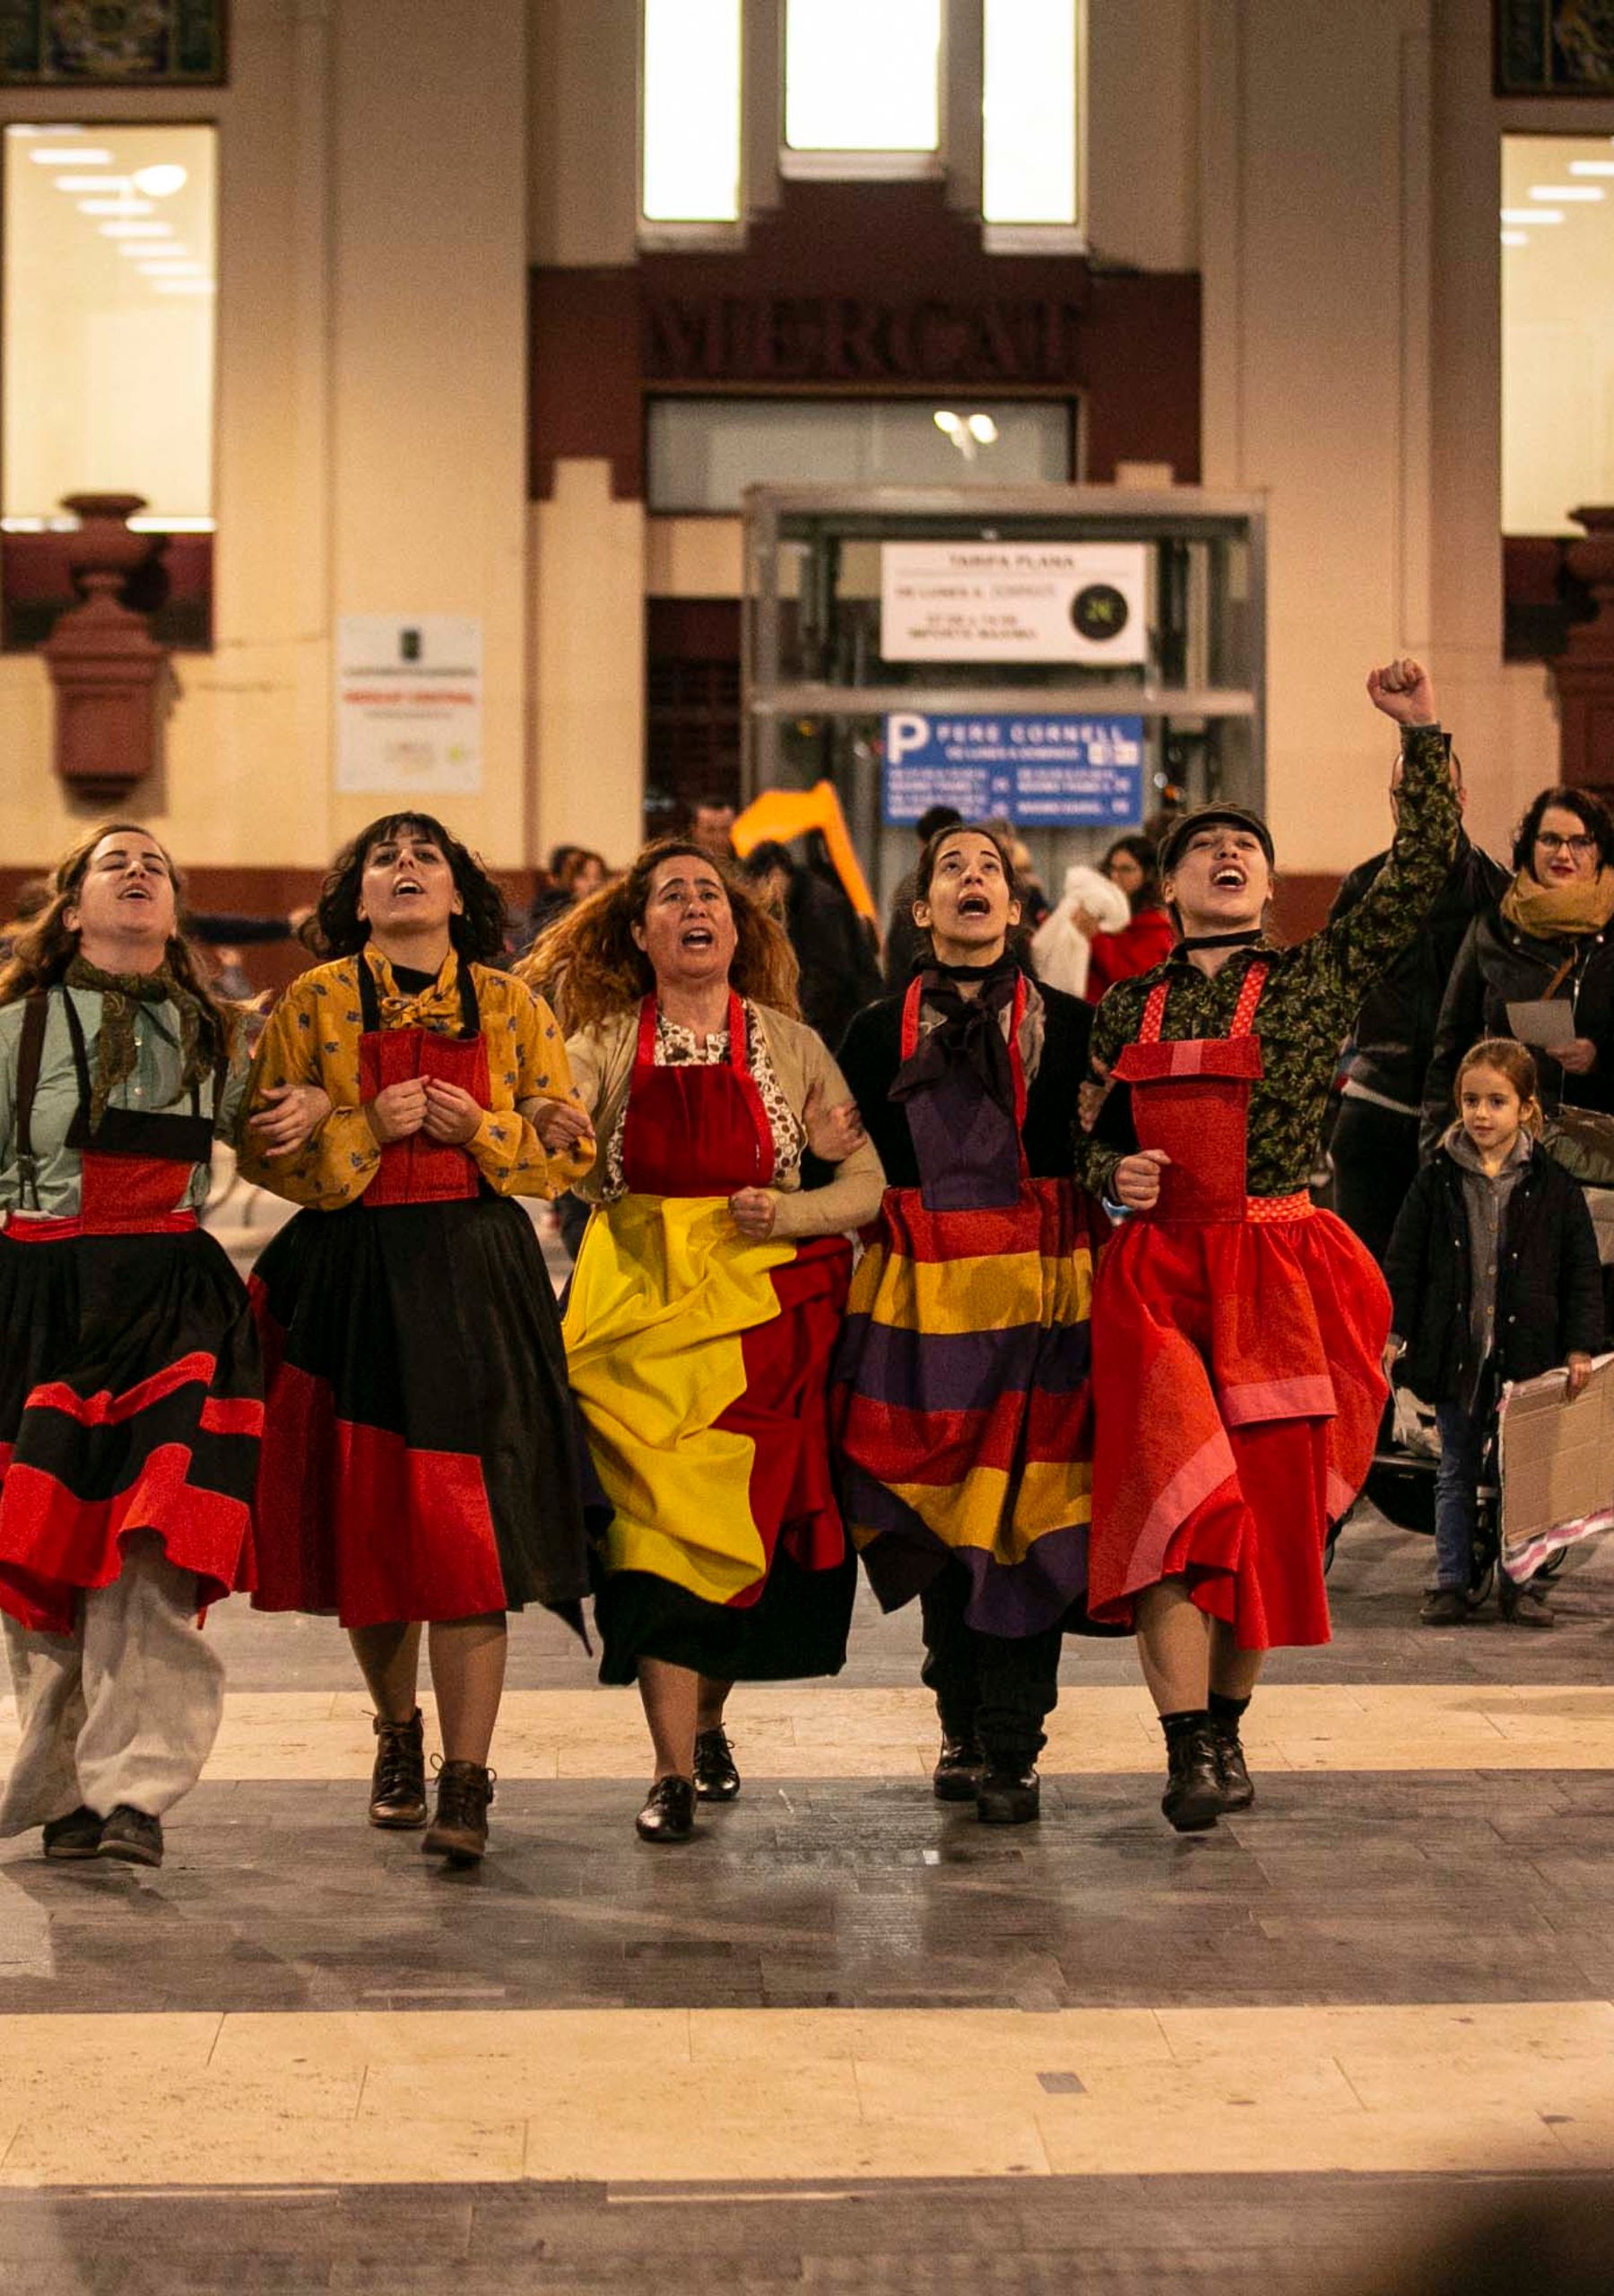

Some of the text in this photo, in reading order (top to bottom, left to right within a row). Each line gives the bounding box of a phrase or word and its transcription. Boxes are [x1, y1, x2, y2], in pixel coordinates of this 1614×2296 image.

[887, 714, 930, 764] P
[936, 723, 1123, 744] PERE CORNELL
